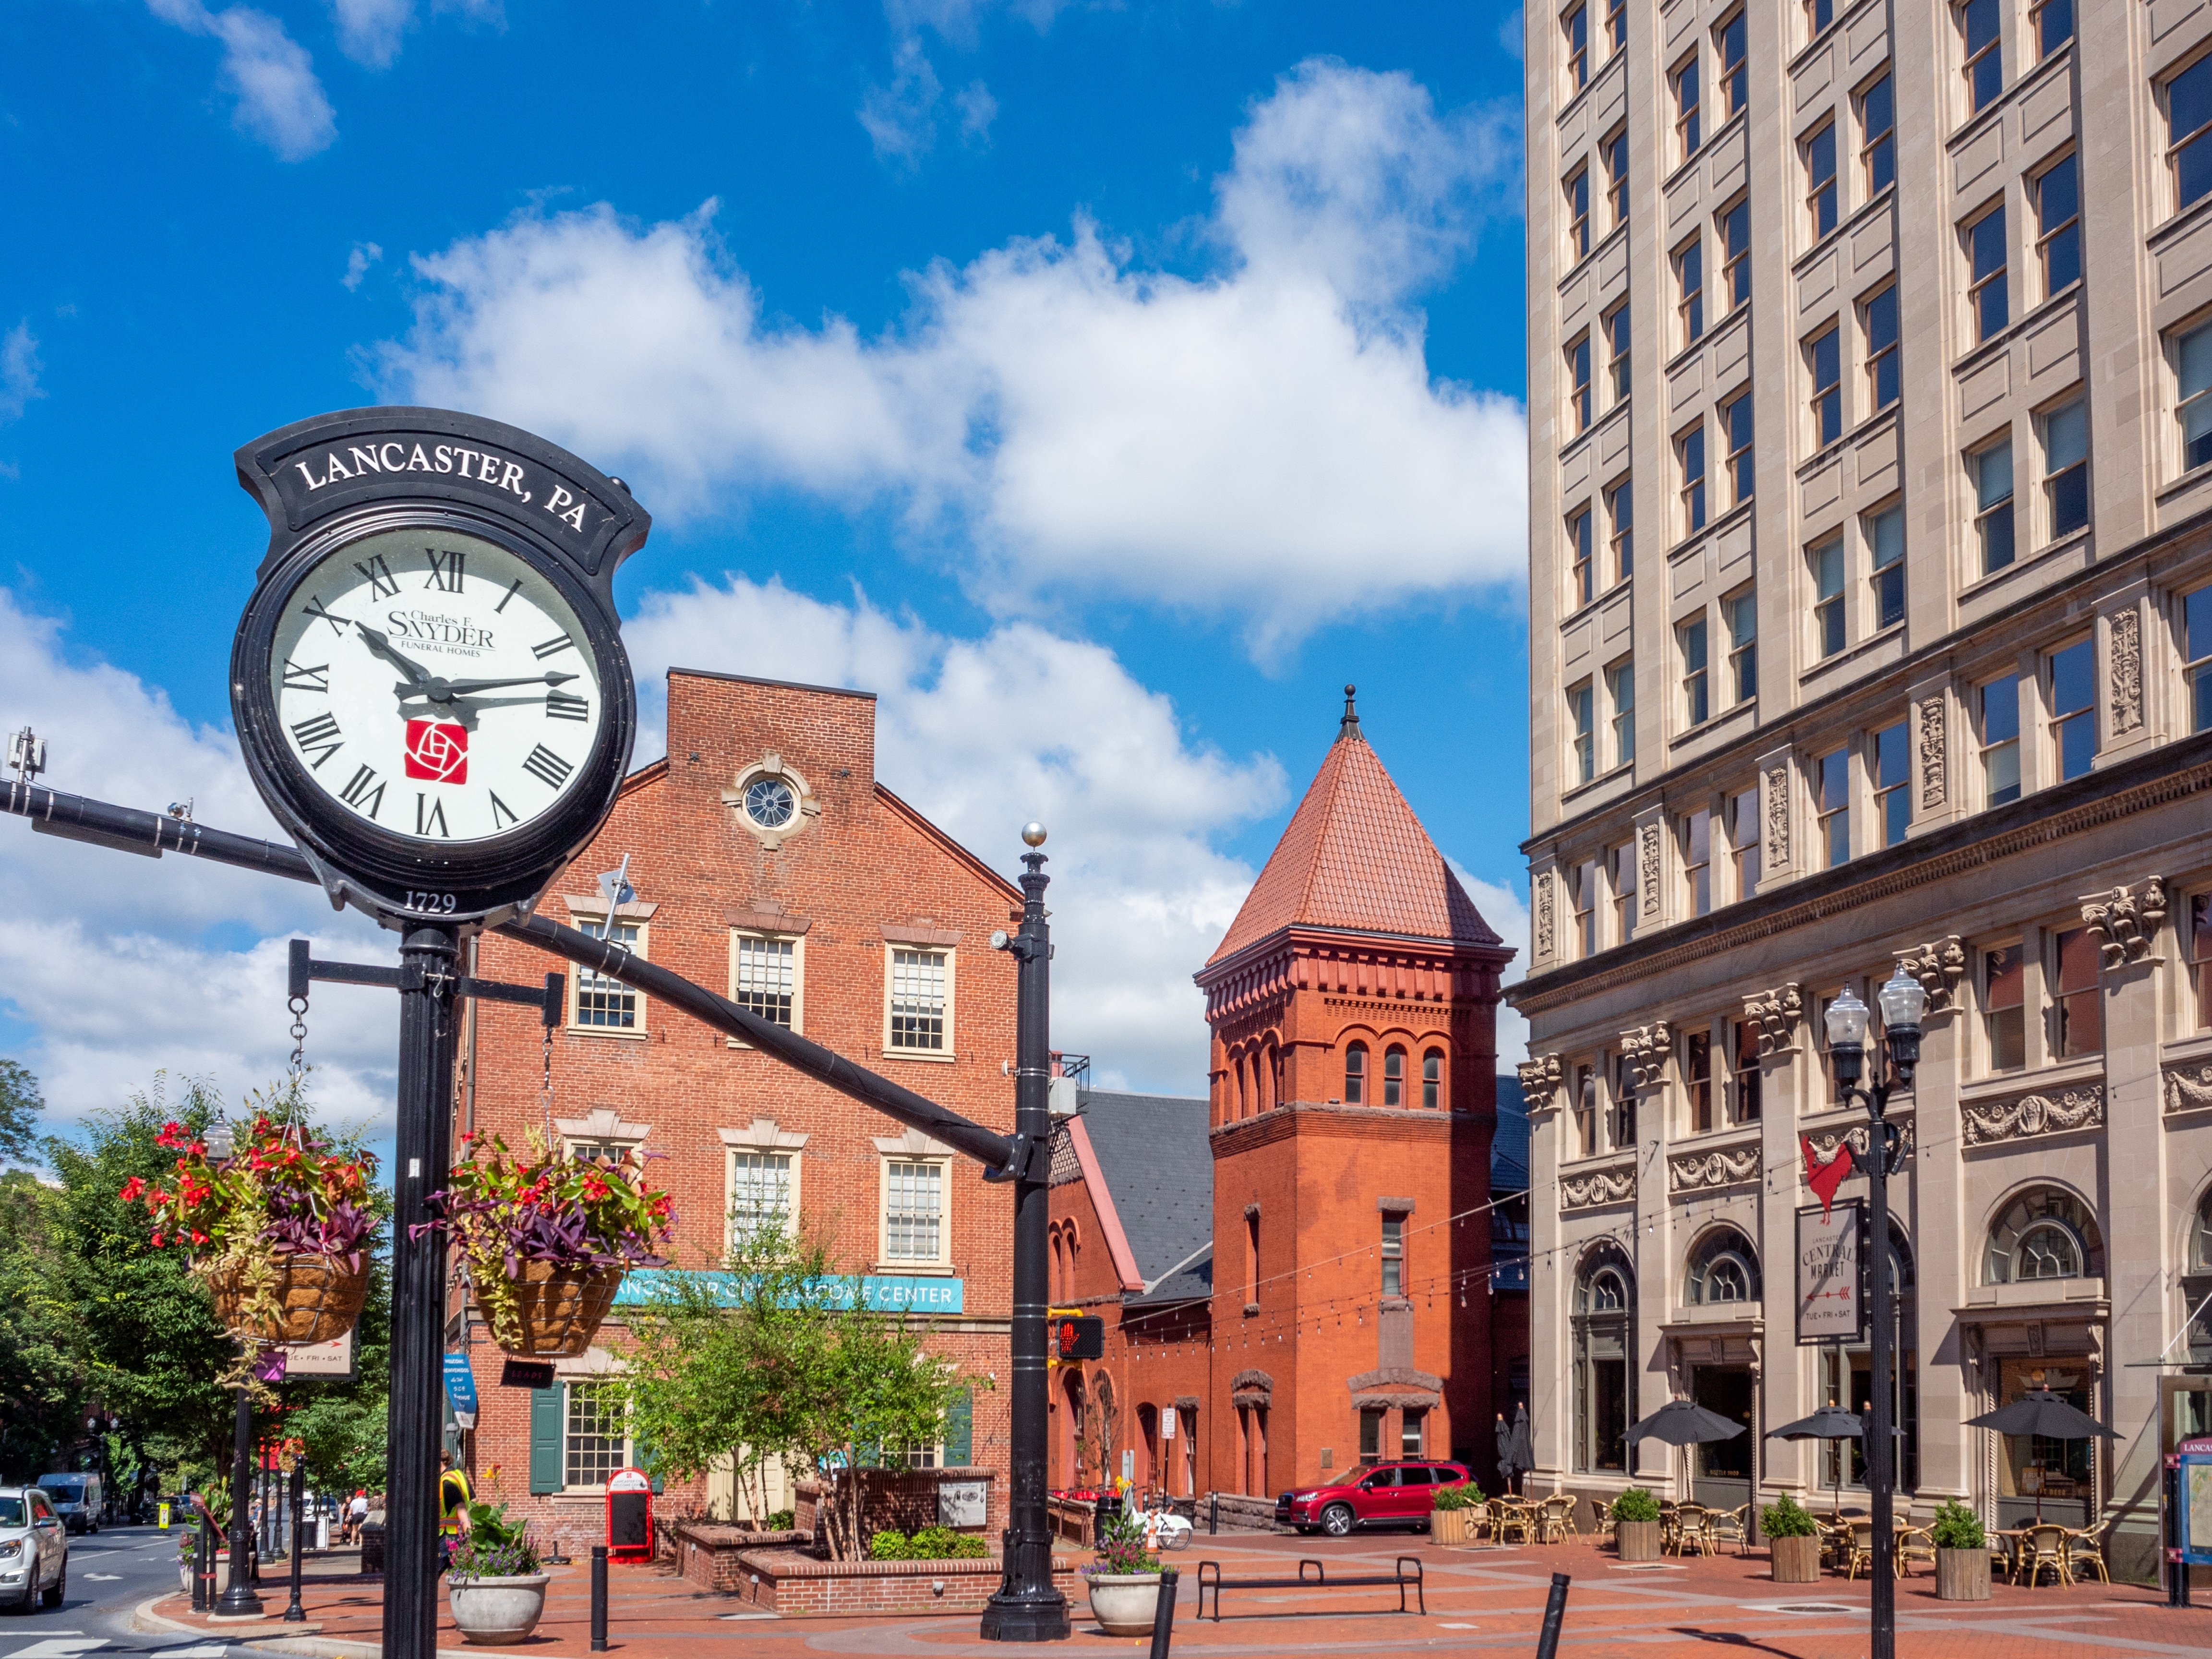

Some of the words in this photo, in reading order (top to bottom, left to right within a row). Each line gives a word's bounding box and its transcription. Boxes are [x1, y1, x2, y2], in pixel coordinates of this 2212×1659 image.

[294, 443, 531, 503] LANCASTER,
[543, 484, 586, 533] PA
[352, 553, 402, 603] XI
[423, 548, 466, 594] XII
[493, 578, 524, 614] I
[302, 594, 352, 638] X
[386, 611, 496, 649] SNYDER
[410, 610, 458, 625] Charles
[463, 616, 473, 627] F.
[401, 640, 444, 653] FUNERAL
[446, 646, 481, 658] HOMES
[530, 632, 575, 661] II
[283, 658, 329, 694] IX
[546, 694, 589, 723] III
[289, 711, 346, 771] VIII
[521, 742, 575, 792] IIII
[337, 763, 388, 820] VII
[488, 787, 520, 830] V
[415, 793, 451, 838] VI
[403, 890, 457, 914] 1729
[1803, 1244, 1853, 1266] CENTRAL
[1812, 1235, 1843, 1244] LANCASTER
[1811, 1262, 1844, 1280] MARKET
[617, 1278, 719, 1296] ANCASER
[778, 1284, 872, 1301] ELCOME
[879, 1286, 952, 1303] CENTER
[1839, 1310, 1851, 1318] SAT
